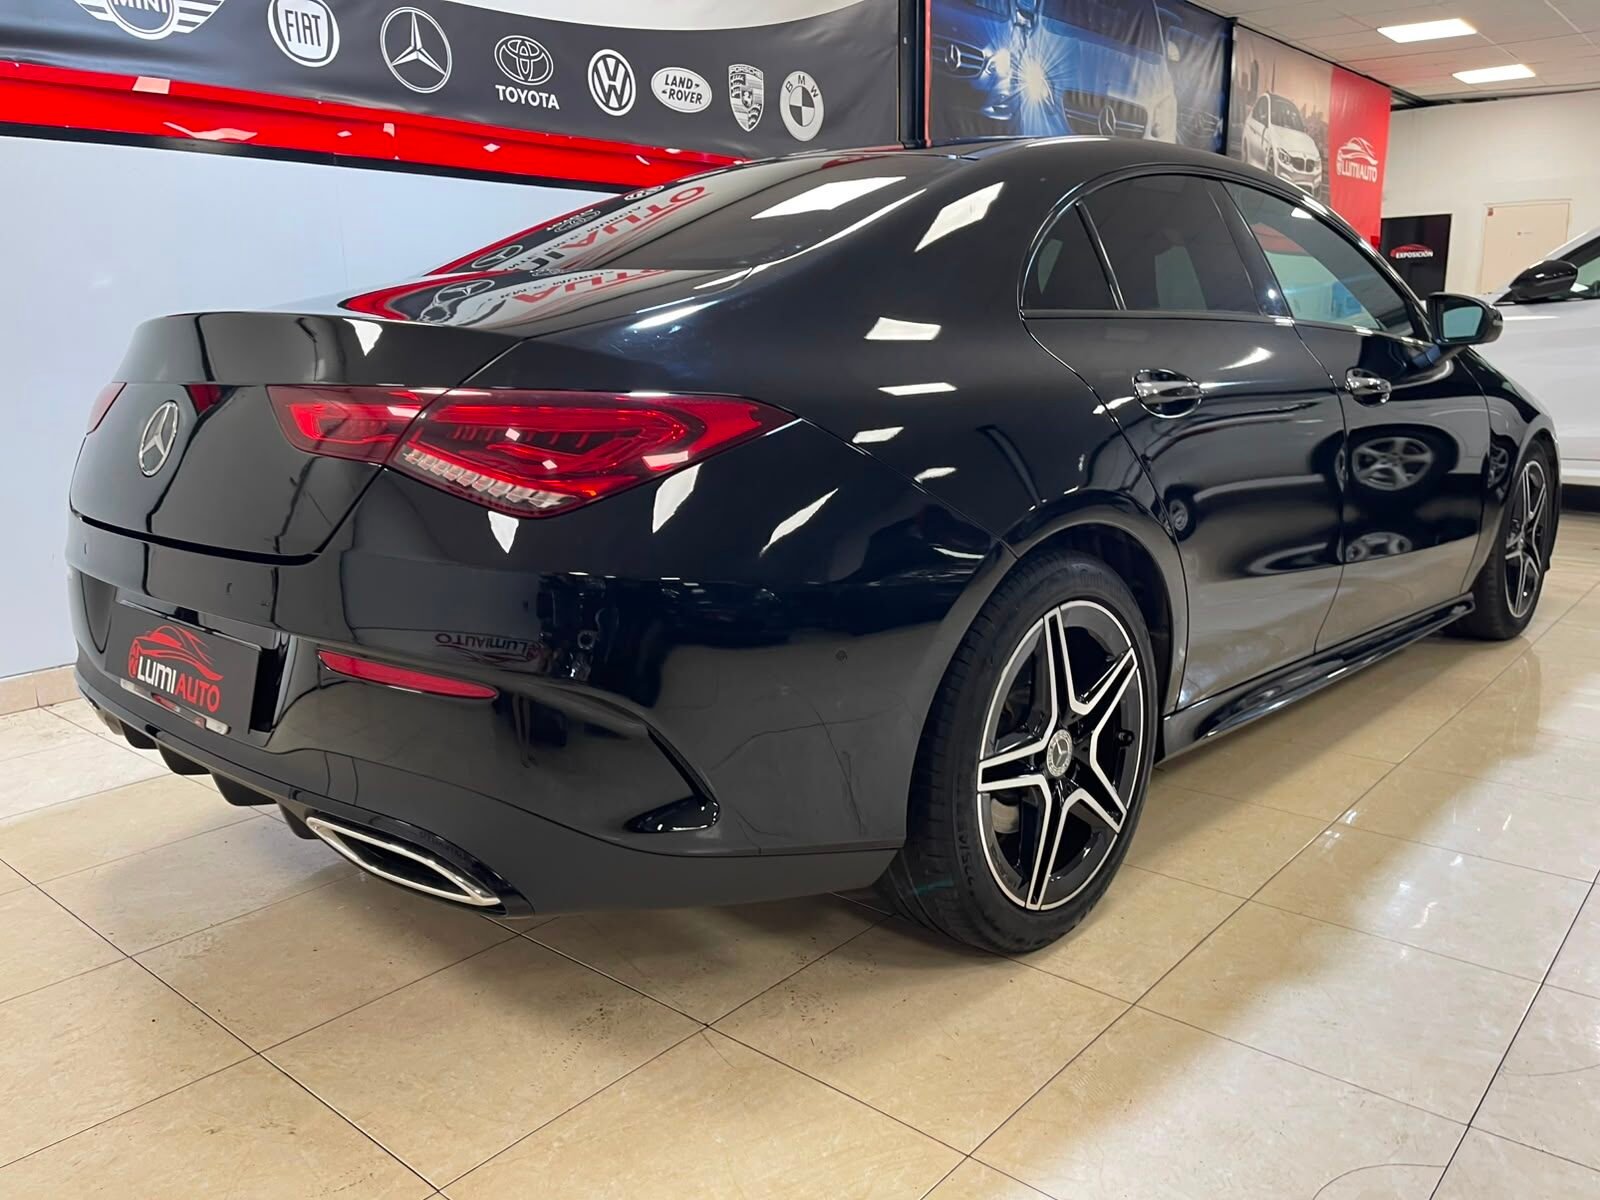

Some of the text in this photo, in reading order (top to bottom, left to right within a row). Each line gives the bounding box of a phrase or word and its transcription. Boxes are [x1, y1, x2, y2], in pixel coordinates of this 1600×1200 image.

[285, 9, 321, 47] FIAT
[495, 84, 560, 110] TOYOTA
[785, 74, 819, 99] BMW
[137, 656, 220, 713] LUMIAUTO
